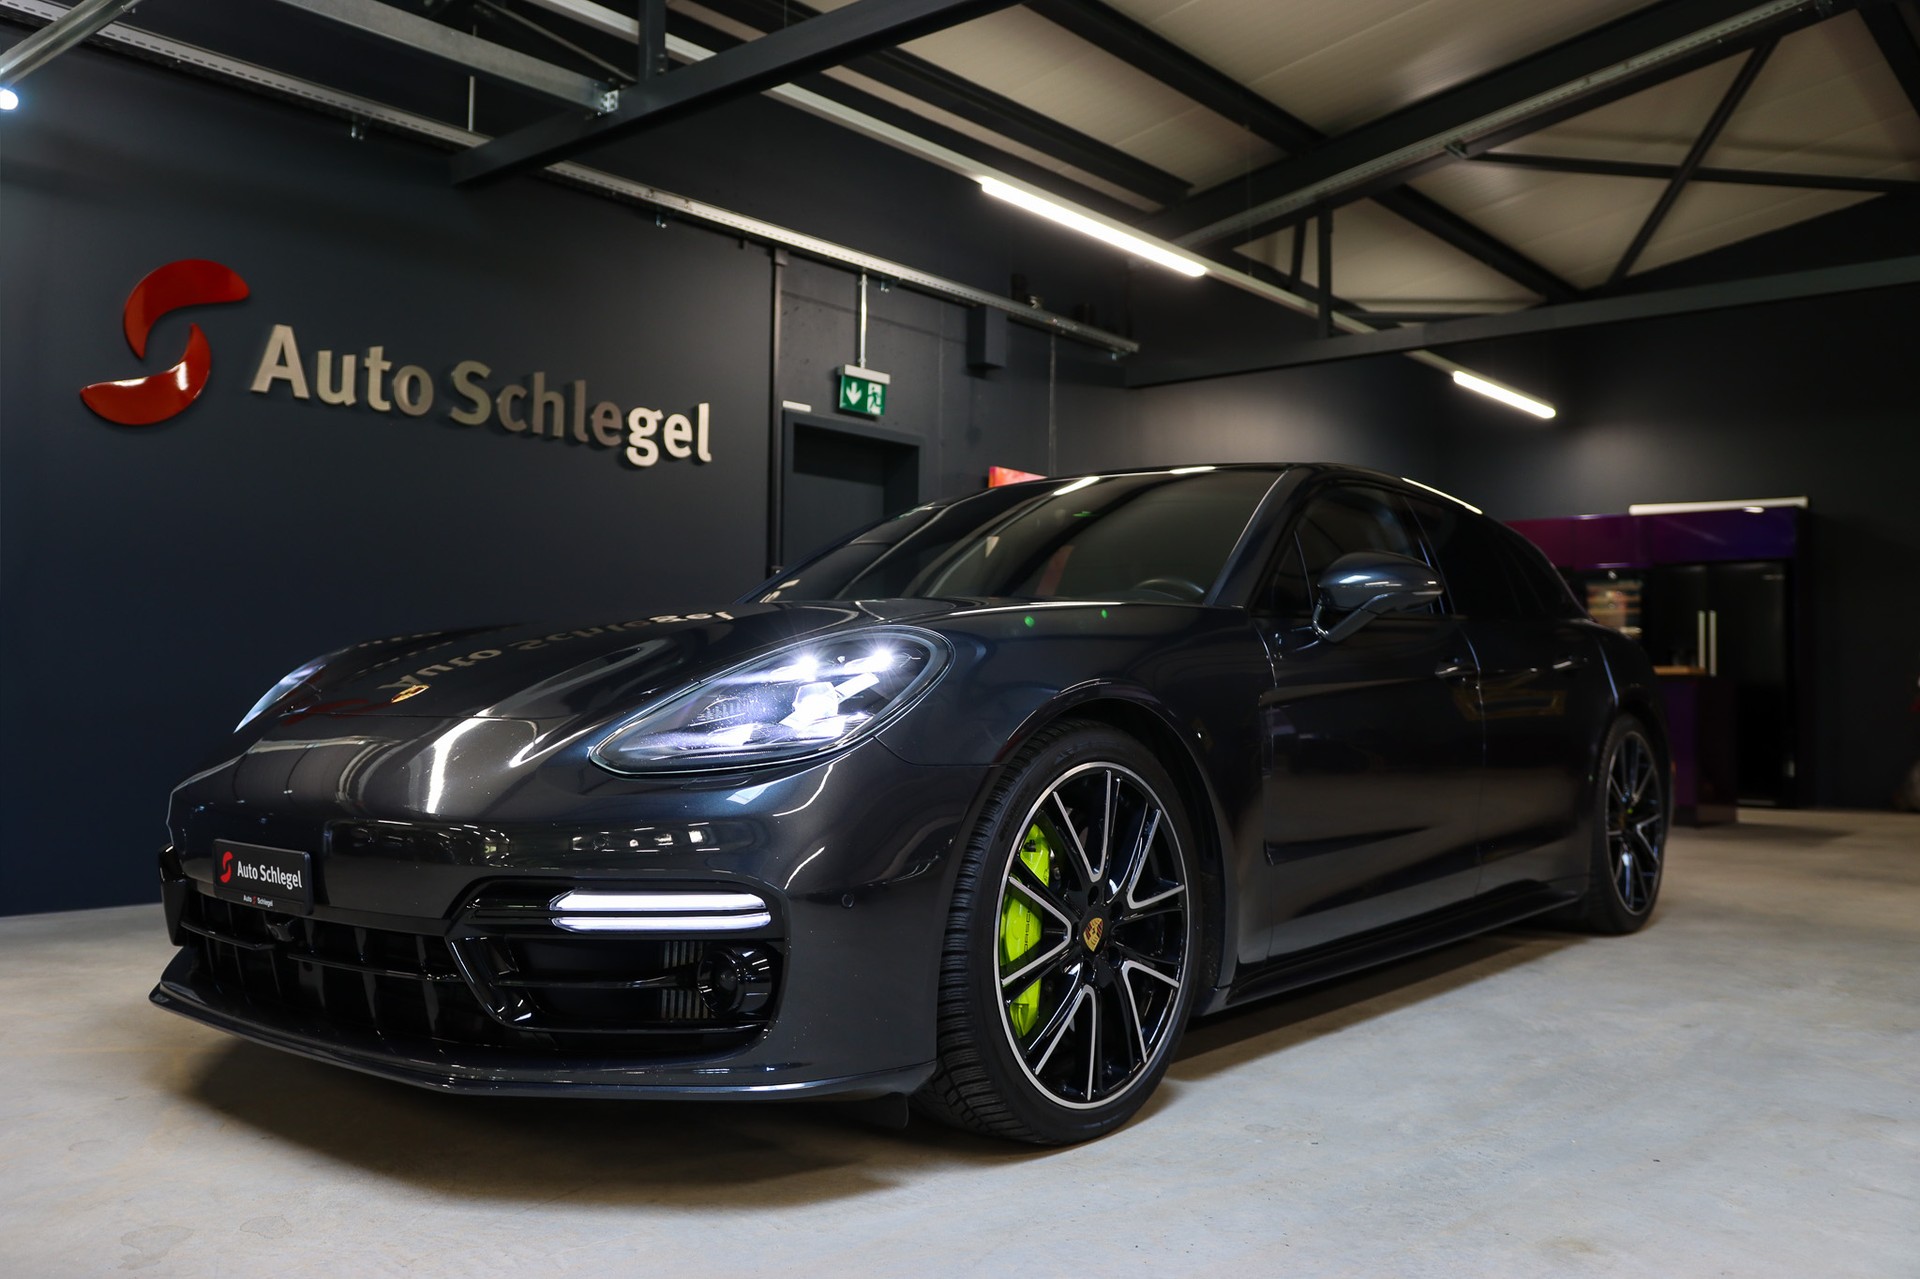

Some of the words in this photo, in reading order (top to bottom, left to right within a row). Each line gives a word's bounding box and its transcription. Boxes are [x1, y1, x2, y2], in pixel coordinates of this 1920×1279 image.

[250, 324, 434, 416] Auto
[450, 360, 712, 468] Schlegel
[237, 860, 258, 880] Auto
[260, 864, 302, 890] Schlegel
